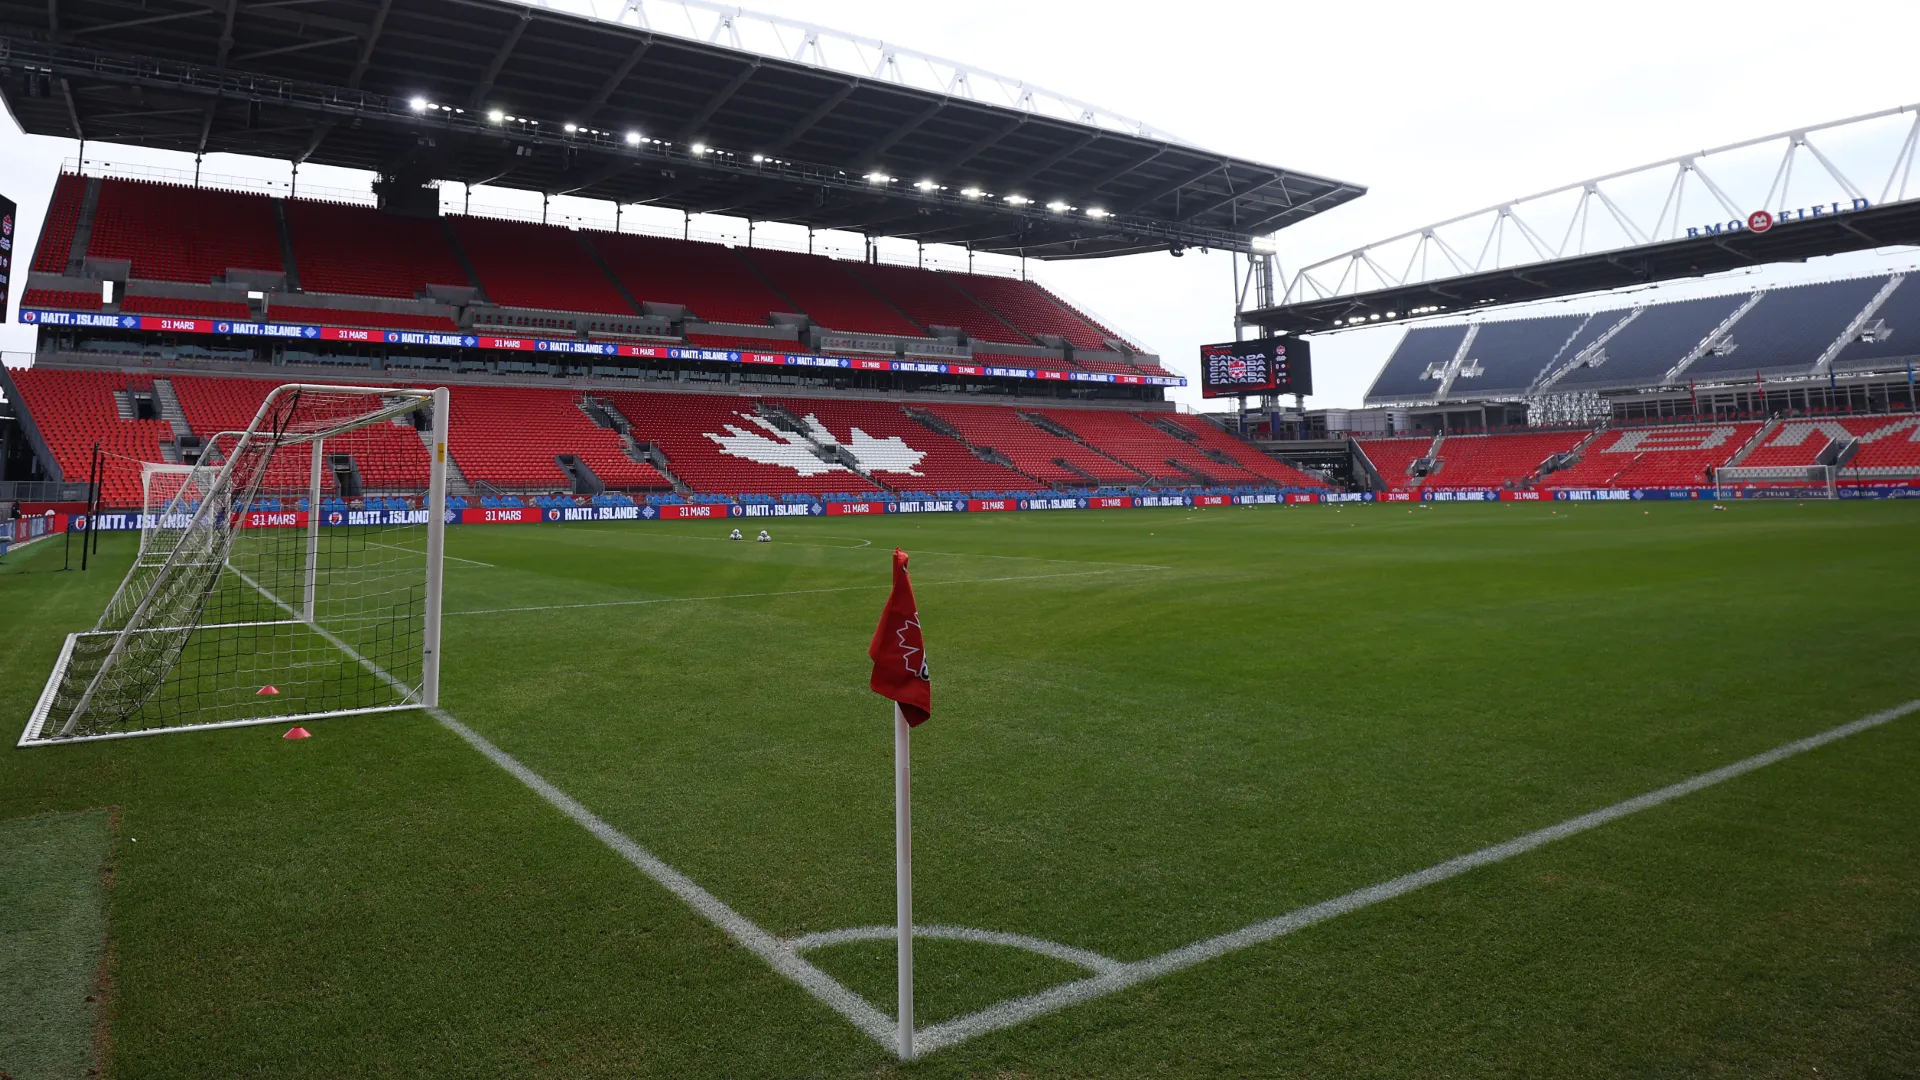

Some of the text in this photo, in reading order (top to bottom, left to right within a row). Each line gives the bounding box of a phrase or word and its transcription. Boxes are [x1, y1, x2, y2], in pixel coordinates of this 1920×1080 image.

[1686, 198, 1869, 239] BMO FIELD
[41, 312, 71, 324] HAITI
[76, 314, 118, 327] ISLANDE
[161, 320, 195, 330] 31 MARS
[233, 324, 259, 335] HAITI
[264, 325, 301, 336] ISLANDE
[349, 331, 367, 339] MARS
[401, 334, 424, 343] HAITI
[429, 335, 461, 345] ISLANDE
[504, 340, 520, 348] MARS
[550, 342, 570, 351] HAITI
[573, 344, 603, 353] ISLANDE
[640, 348, 654, 356] MARS
[681, 349, 698, 359] HAITI
[702, 351, 728, 361] ISLANDE
[797, 356, 812, 366] HAITI
[816, 357, 839, 367] ISLANDE
[900, 362, 914, 370] HAITI
[918, 363, 938, 372] ISLANDE
[993, 368, 1006, 376] HAITI
[1241, 495, 1254, 504] HAITI
[1257, 495, 1276, 503] ISLANDE
[1434, 492, 1453, 500] HAITI
[1457, 492, 1484, 500] ISLANDE
[1570, 491, 1591, 500] HAITI
[1597, 491, 1630, 500] ISLANDE
[900, 502, 919, 512] HAITI
[924, 501, 953, 512] ISLANDE
[1030, 500, 1047, 509] HAITI
[1051, 499, 1076, 509] ISLANDE
[1143, 497, 1158, 506] HAITI
[1161, 497, 1183, 506] ISLANDE
[565, 508, 592, 520] HAITI
[599, 507, 638, 520] ISLANDE
[680, 507, 710, 516] 31 MARS
[746, 505, 769, 516] HAITI
[775, 504, 808, 516] ISLANDE
[843, 504, 869, 513] 31 MARS
[253, 514, 296, 525] 31 MARS
[349, 511, 381, 524] HAITI
[389, 510, 430, 524] ISLAND
[486, 511, 521, 520] 31 MARS
[128, 521, 134, 529] v
